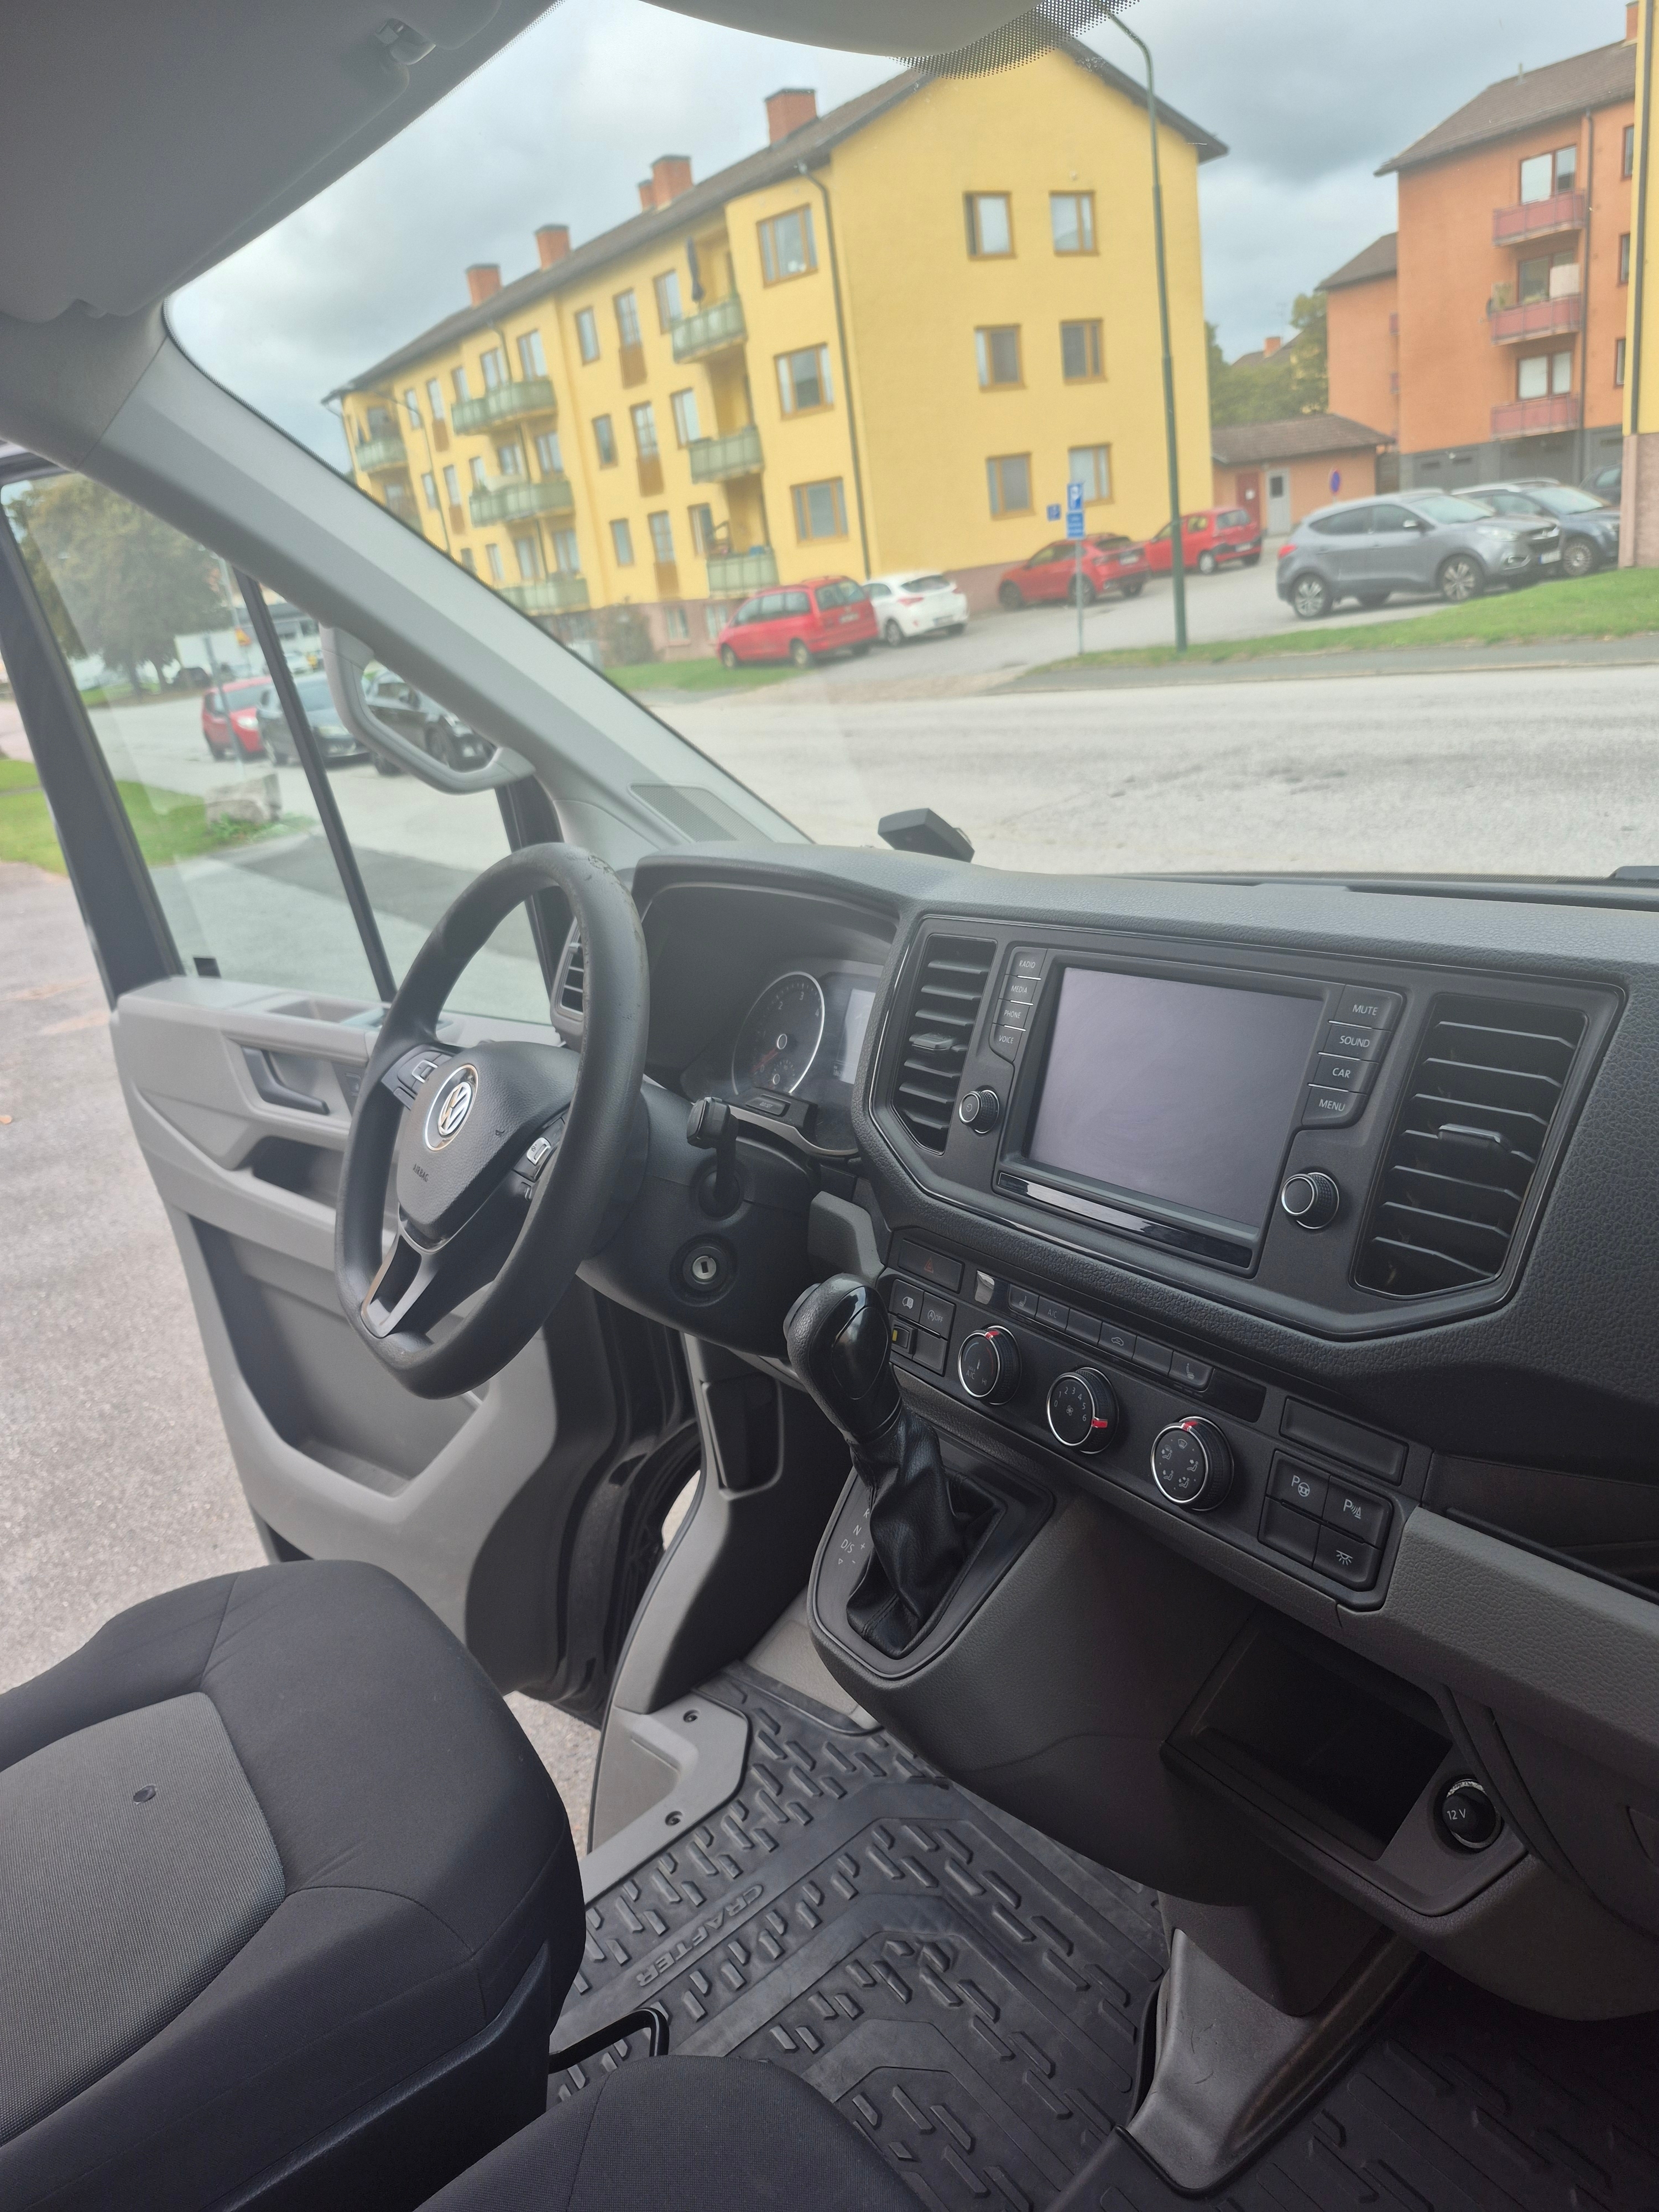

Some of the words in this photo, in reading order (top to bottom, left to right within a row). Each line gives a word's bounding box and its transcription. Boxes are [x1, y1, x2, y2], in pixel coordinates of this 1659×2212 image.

[1019, 960, 1036, 968] RADIO
[1011, 985, 1027, 994] MEDIA
[799, 992, 805, 1000] 3
[778, 1001, 783, 1010] 2
[1352, 1004, 1378, 1015] MUTE
[815, 1008, 820, 1017] 4
[1004, 1010, 1021, 1019] PHONE
[999, 1035, 1014, 1044] VOICE
[1339, 1035, 1370, 1047] SOUND
[1332, 1067, 1351, 1078] CAR
[1318, 1098, 1345, 1112] MENU
[413, 1164, 429, 1182] AIRBAG
[935, 1314, 943, 1323] OFF
[1047, 1309, 1057, 1318] A/C
[966, 1370, 975, 1380] A/C
[863, 1508, 870, 1518] R
[853, 1525, 862, 1536] N
[841, 1539, 855, 1553] D/S
[1447, 1809, 1458, 1820] 12
[1458, 1808, 1466, 1818] V
[636, 1884, 764, 1986] CRAFTER
